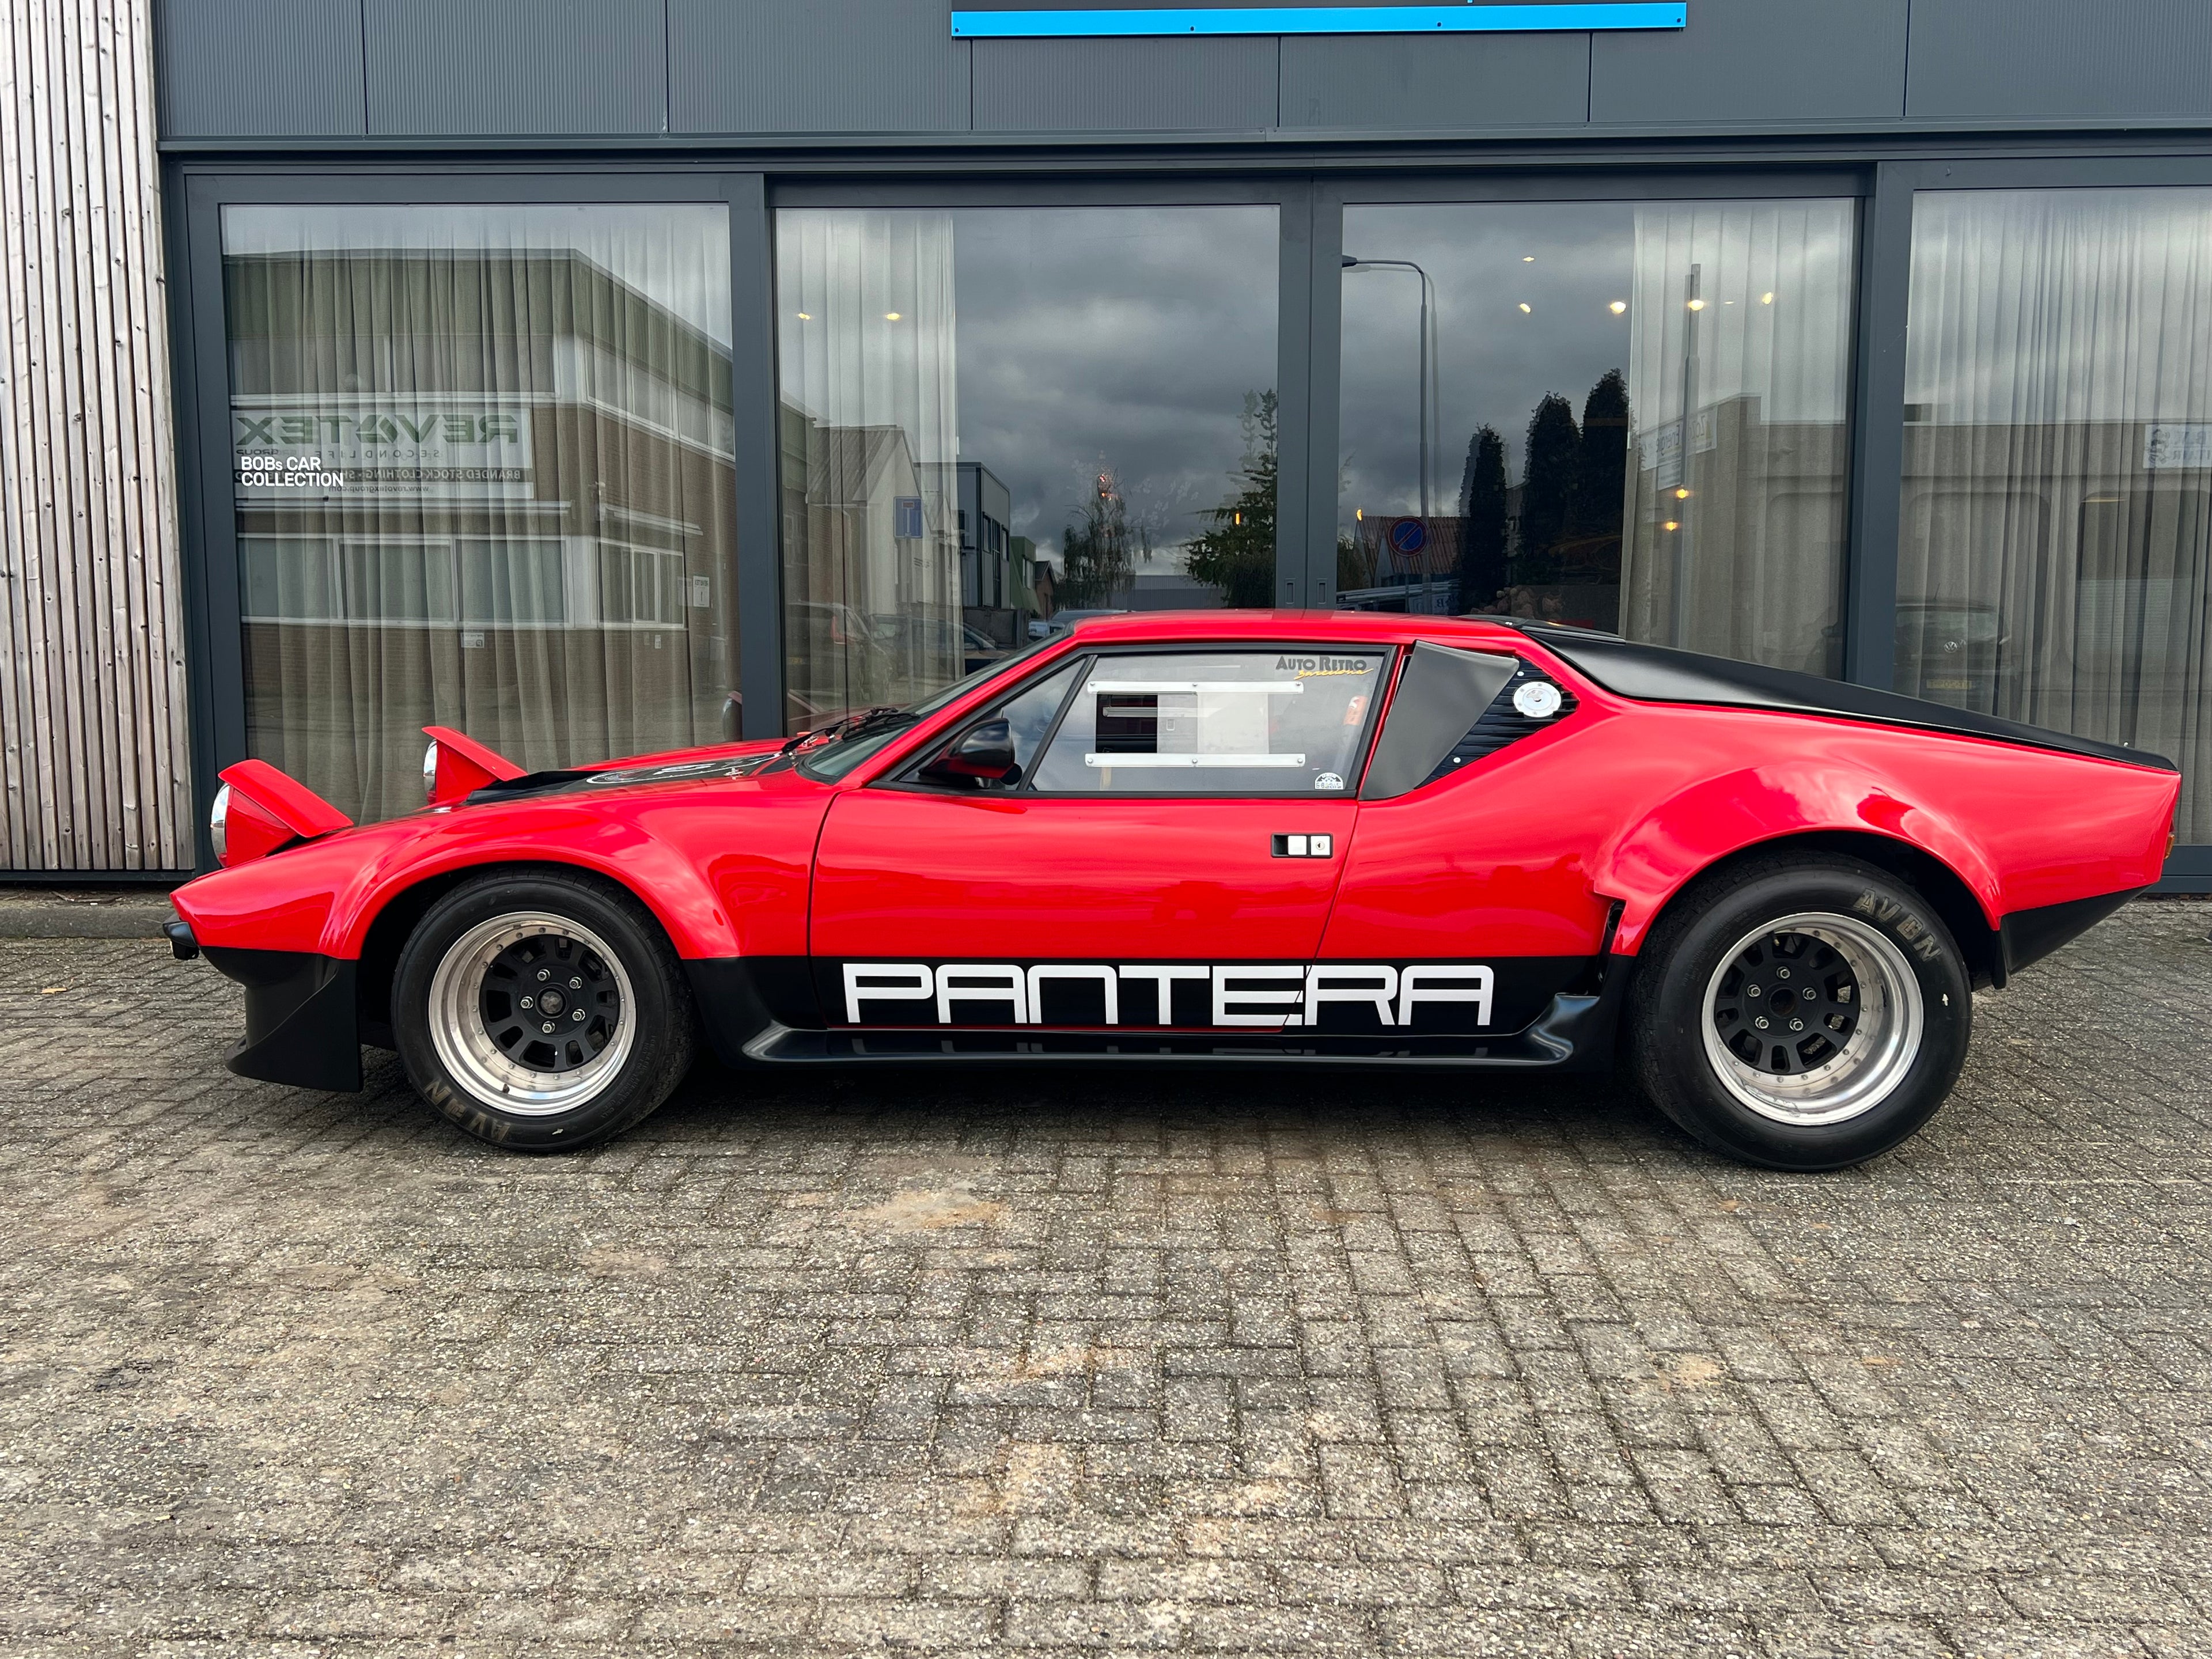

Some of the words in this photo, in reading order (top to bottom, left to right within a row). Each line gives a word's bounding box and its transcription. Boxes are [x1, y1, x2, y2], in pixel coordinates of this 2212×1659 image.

[241, 456, 283, 471] BOBs
[287, 456, 321, 471] CAR
[241, 472, 344, 487] COLLECTION
[843, 964, 1494, 1025] PANTERA
